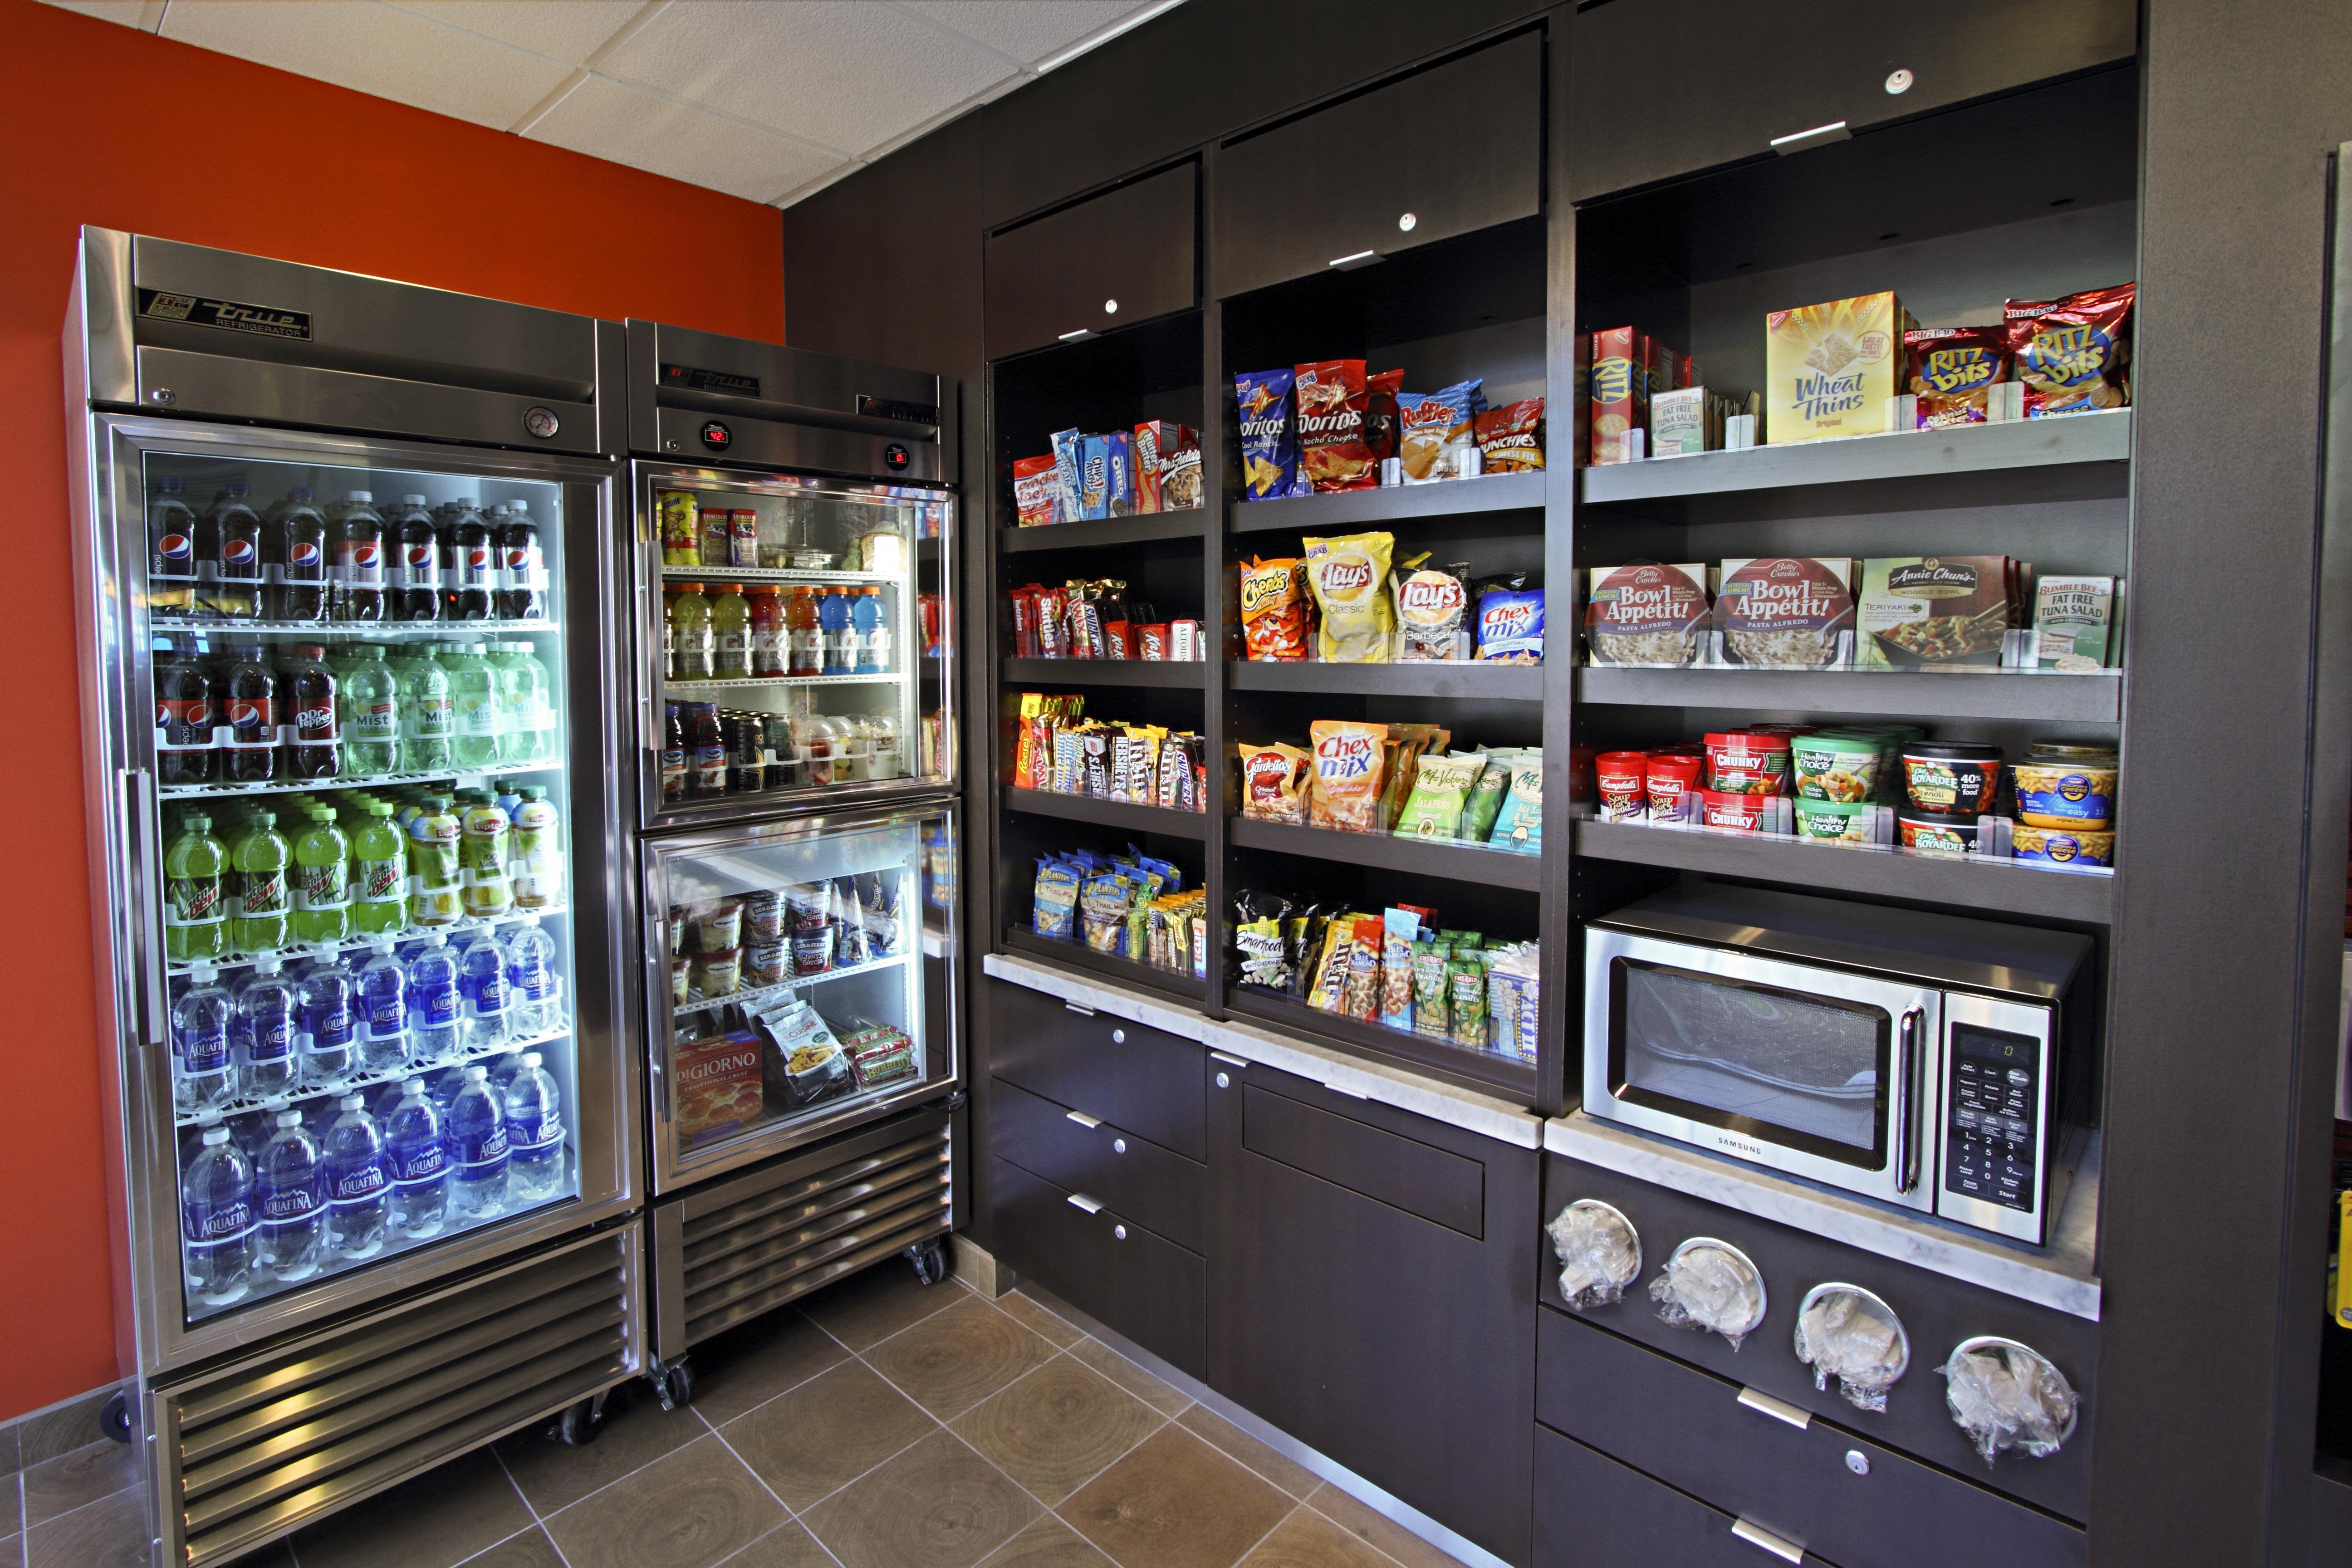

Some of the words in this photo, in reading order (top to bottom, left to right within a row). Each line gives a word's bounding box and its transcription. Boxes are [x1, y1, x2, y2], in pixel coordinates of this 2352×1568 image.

[2007, 309, 2032, 319] BIG
[2034, 304, 2058, 317] BAG
[216, 319, 301, 337] REFRIGERATOR
[1911, 329, 1932, 340] BIG
[1933, 328, 1955, 338] BAG
[2032, 324, 2097, 366] RITZ
[1929, 347, 1984, 375] RITZ
[2039, 346, 2106, 384] bits
[1593, 358, 1630, 401] RITZ
[1929, 361, 1991, 392] bits
[1794, 372, 1867, 402] Wheat
[1654, 396, 1679, 410] BUMBLE
[1663, 405, 1674, 416] FAT
[1676, 404, 1691, 412] FREE
[1791, 394, 1865, 421] Thins
[1401, 400, 1458, 432] Ruffles
[2038, 404, 2090, 420] Cheese
[1299, 410, 1362, 434] Doritos
[1656, 416, 1675, 428] TUNA
[1676, 413, 1698, 423] SALAD
[1816, 418, 1842, 428] Original
[1303, 436, 1324, 446] Nacho
[1328, 433, 1358, 444] Cheese
[1137, 439, 1152, 471] Butter
[1145, 431, 1158, 466] Nutter
[1522, 452, 1536, 462] FIX
[1056, 454, 1073, 488] TREATS
[1112, 456, 1123, 495] OREO
[1308, 547, 1328, 559] GRAB
[1640, 569, 1658, 578] Betty
[1770, 568, 1800, 578] Crocker
[1777, 562, 1797, 572] Betty
[1323, 562, 1370, 591] Lay's
[1635, 575, 1661, 584] Crocker
[1891, 569, 1932, 583] Annie
[1933, 567, 1975, 582] Chun's
[1243, 571, 1289, 608] Cheetos
[1618, 585, 1671, 605] Bowl
[1751, 579, 1810, 600] Bowl
[2039, 583, 2078, 596] BUMBLE
[2081, 584, 2098, 593] BEE
[2052, 594, 2069, 605] FAT
[2071, 594, 2094, 605] FREE
[1328, 604, 1365, 614] Classic
[1485, 601, 1537, 624] Chex
[1604, 601, 1689, 624] Appétit!
[1733, 595, 1830, 620] Appétit!
[2041, 607, 2068, 616] TUNA
[2069, 605, 2103, 618] SALAD
[1014, 598, 1023, 632] Twizzlers
[1071, 593, 1087, 637] TWIX
[1040, 597, 1055, 649] Skittles
[1485, 616, 1529, 638] mix
[1640, 621, 1671, 630] ALFREDO
[1773, 619, 1808, 627] ALFREDO
[1084, 605, 1103, 656] SNICKERS
[1407, 631, 1455, 641] Barbecue
[298, 712, 332, 729] Pepper
[309, 710, 323, 720] Dr
[357, 714, 389, 726] Mist
[1318, 734, 1378, 758] Chex
[1115, 736, 1127, 789] HERSHEY'S
[1320, 751, 1372, 778] mix
[1716, 754, 1762, 769] CHUNKY
[1801, 752, 1832, 763] Healthy
[1245, 756, 1291, 784] Gardetto's
[1798, 760, 1830, 770] Choice
[1177, 751, 1193, 804] SNICKERS
[1602, 779, 1637, 790] Campbell's
[1911, 774, 1959, 788] BOYARDEE
[1960, 774, 1981, 784] 40%
[1328, 785, 1365, 795] Cheddar
[1648, 779, 1680, 793] Campbell's
[1414, 797, 1450, 809] JALAPEÑO
[1607, 793, 1632, 805] Soup
[1651, 795, 1673, 807] Soup
[1609, 804, 1632, 815] Hand
[2067, 809, 2089, 818] easy
[1710, 812, 1754, 828] CHUNKY
[1811, 815, 1847, 826] Healthy
[1808, 823, 1845, 833] Choice
[1915, 839, 1965, 852] BOYARDEE
[1046, 871, 1070, 882] PLANTERS
[1046, 886, 1061, 896] TRAIL
[1095, 884, 1120, 896] PLANTERS
[1095, 901, 1112, 910] TRAIL
[1236, 930, 1282, 956] Smartfood
[1387, 945, 1405, 953] BLUE
[801, 952, 824, 960] Cherry
[1355, 952, 1369, 961] BLUE
[1419, 955, 1444, 963] EMERALD
[1415, 973, 1444, 983] Peanuts
[1426, 967, 1446, 976] Roasted
[1454, 974, 1479, 983] EMERALD
[1460, 987, 1481, 996] Roasted
[1520, 999, 1536, 1032] ACT
[676, 1053, 755, 1082] DIGIORNO
[866, 1056, 909, 1079] BURRITO
[685, 1078, 726, 1092] TRADITIONAL
[729, 1071, 748, 1079] CRUST
[1718, 1137, 1761, 1155] SAMSUNG
[338, 1169, 383, 1197] AQUAFINA
[1999, 1190, 2016, 1199] Start
[264, 1192, 312, 1216] AQUAFINA
[201, 1206, 250, 1238] AQUAFINA
